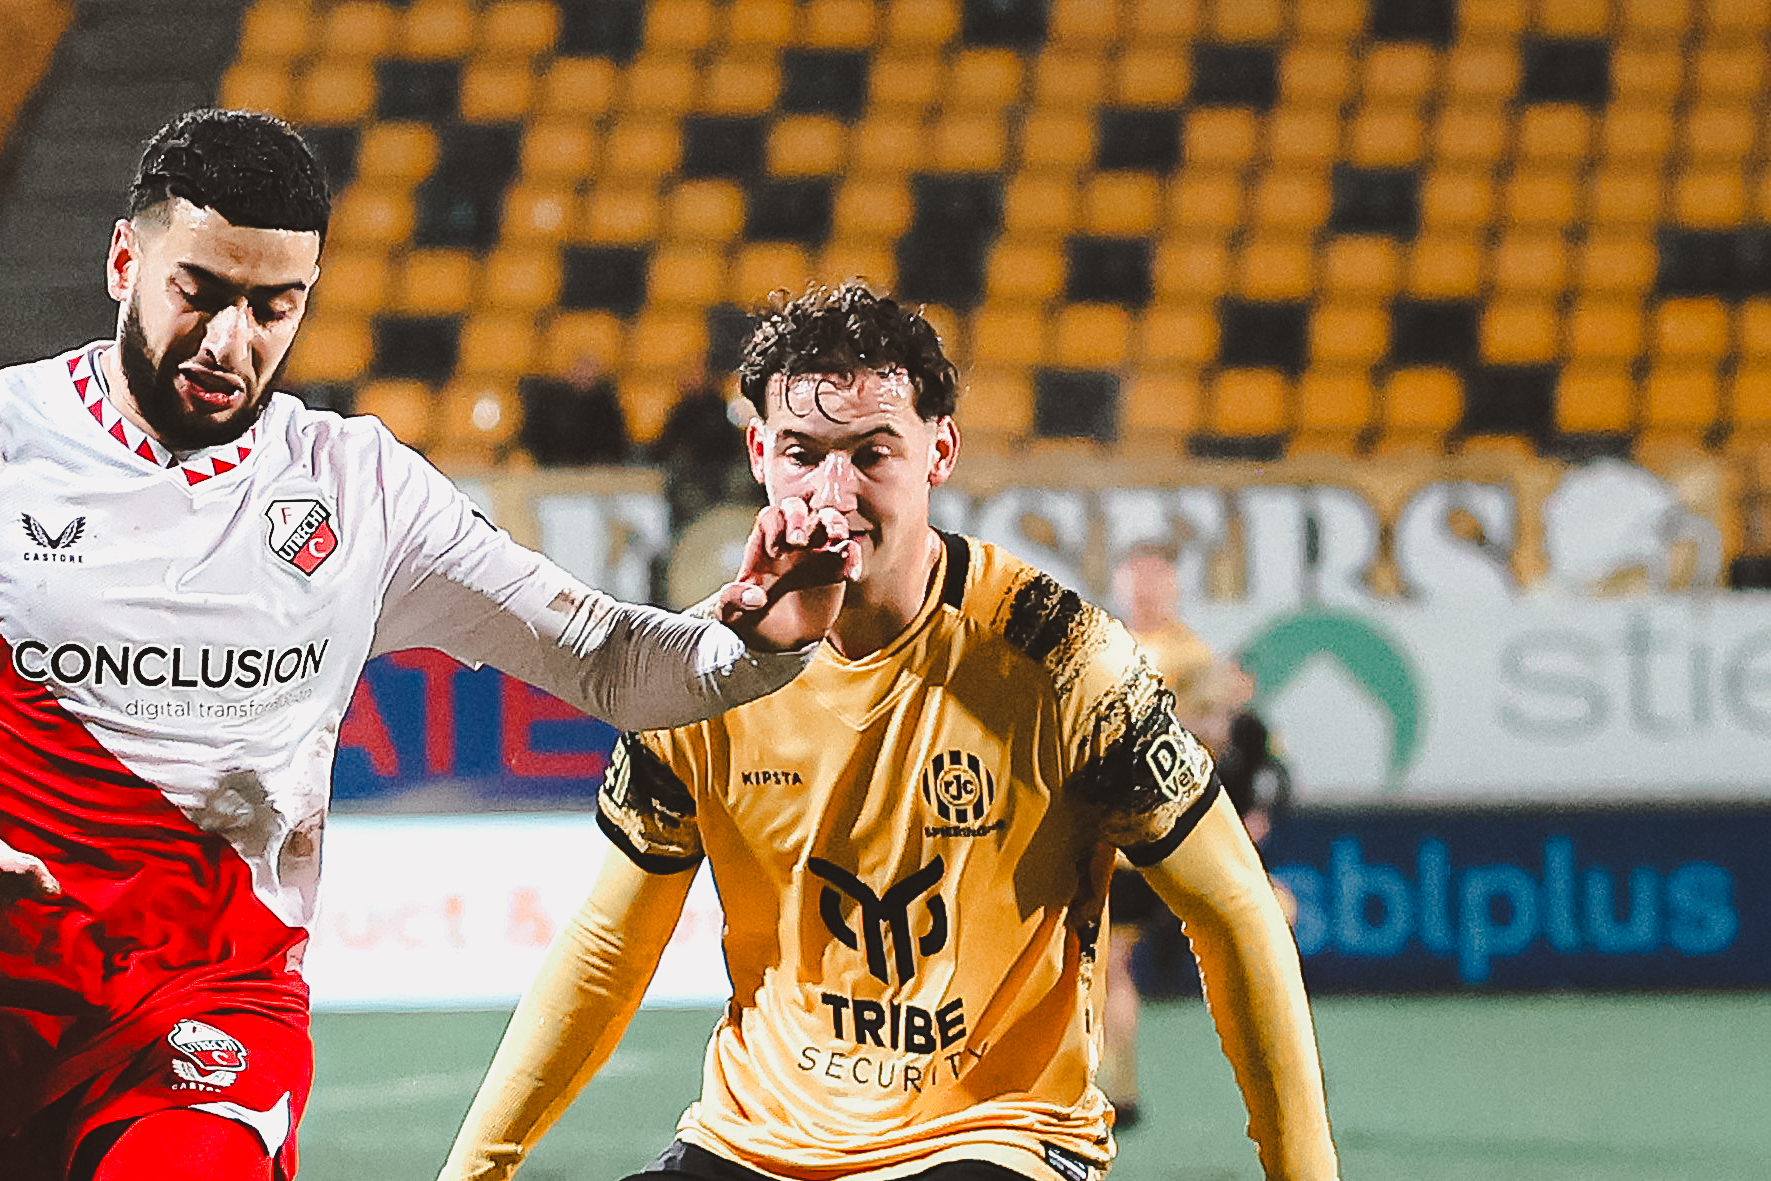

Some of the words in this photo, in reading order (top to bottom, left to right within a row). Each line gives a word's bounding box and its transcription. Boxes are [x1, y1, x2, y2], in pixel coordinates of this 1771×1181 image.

[23, 552, 84, 563] CASTORE
[13, 638, 329, 690] CONCLUSION
[125, 699, 191, 720] digital
[741, 770, 804, 787] KIPSTA
[821, 993, 967, 1054] TRIBE
[797, 1043, 991, 1094] SECURITY
